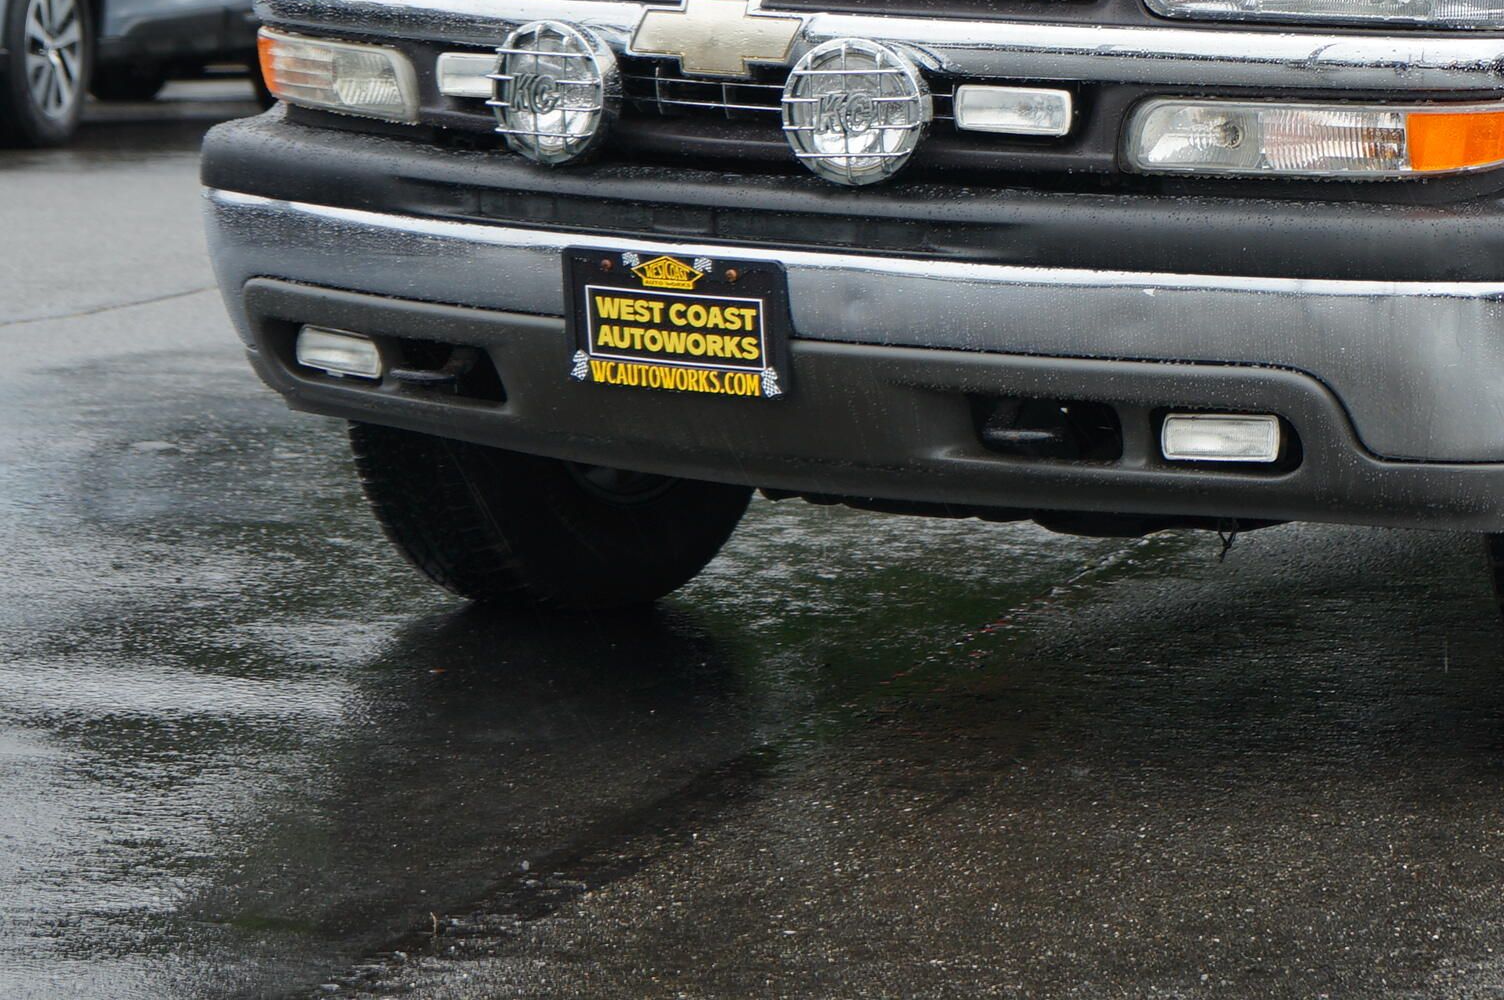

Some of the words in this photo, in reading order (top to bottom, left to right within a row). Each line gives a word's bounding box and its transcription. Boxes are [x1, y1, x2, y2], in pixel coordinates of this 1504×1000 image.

[510, 72, 560, 114] KC
[815, 92, 877, 136] KC
[595, 296, 664, 323] WEST
[668, 303, 757, 330] COAST
[597, 325, 760, 359] AUTOWORKS
[590, 360, 760, 396] WCAUTOWORKS.COM
